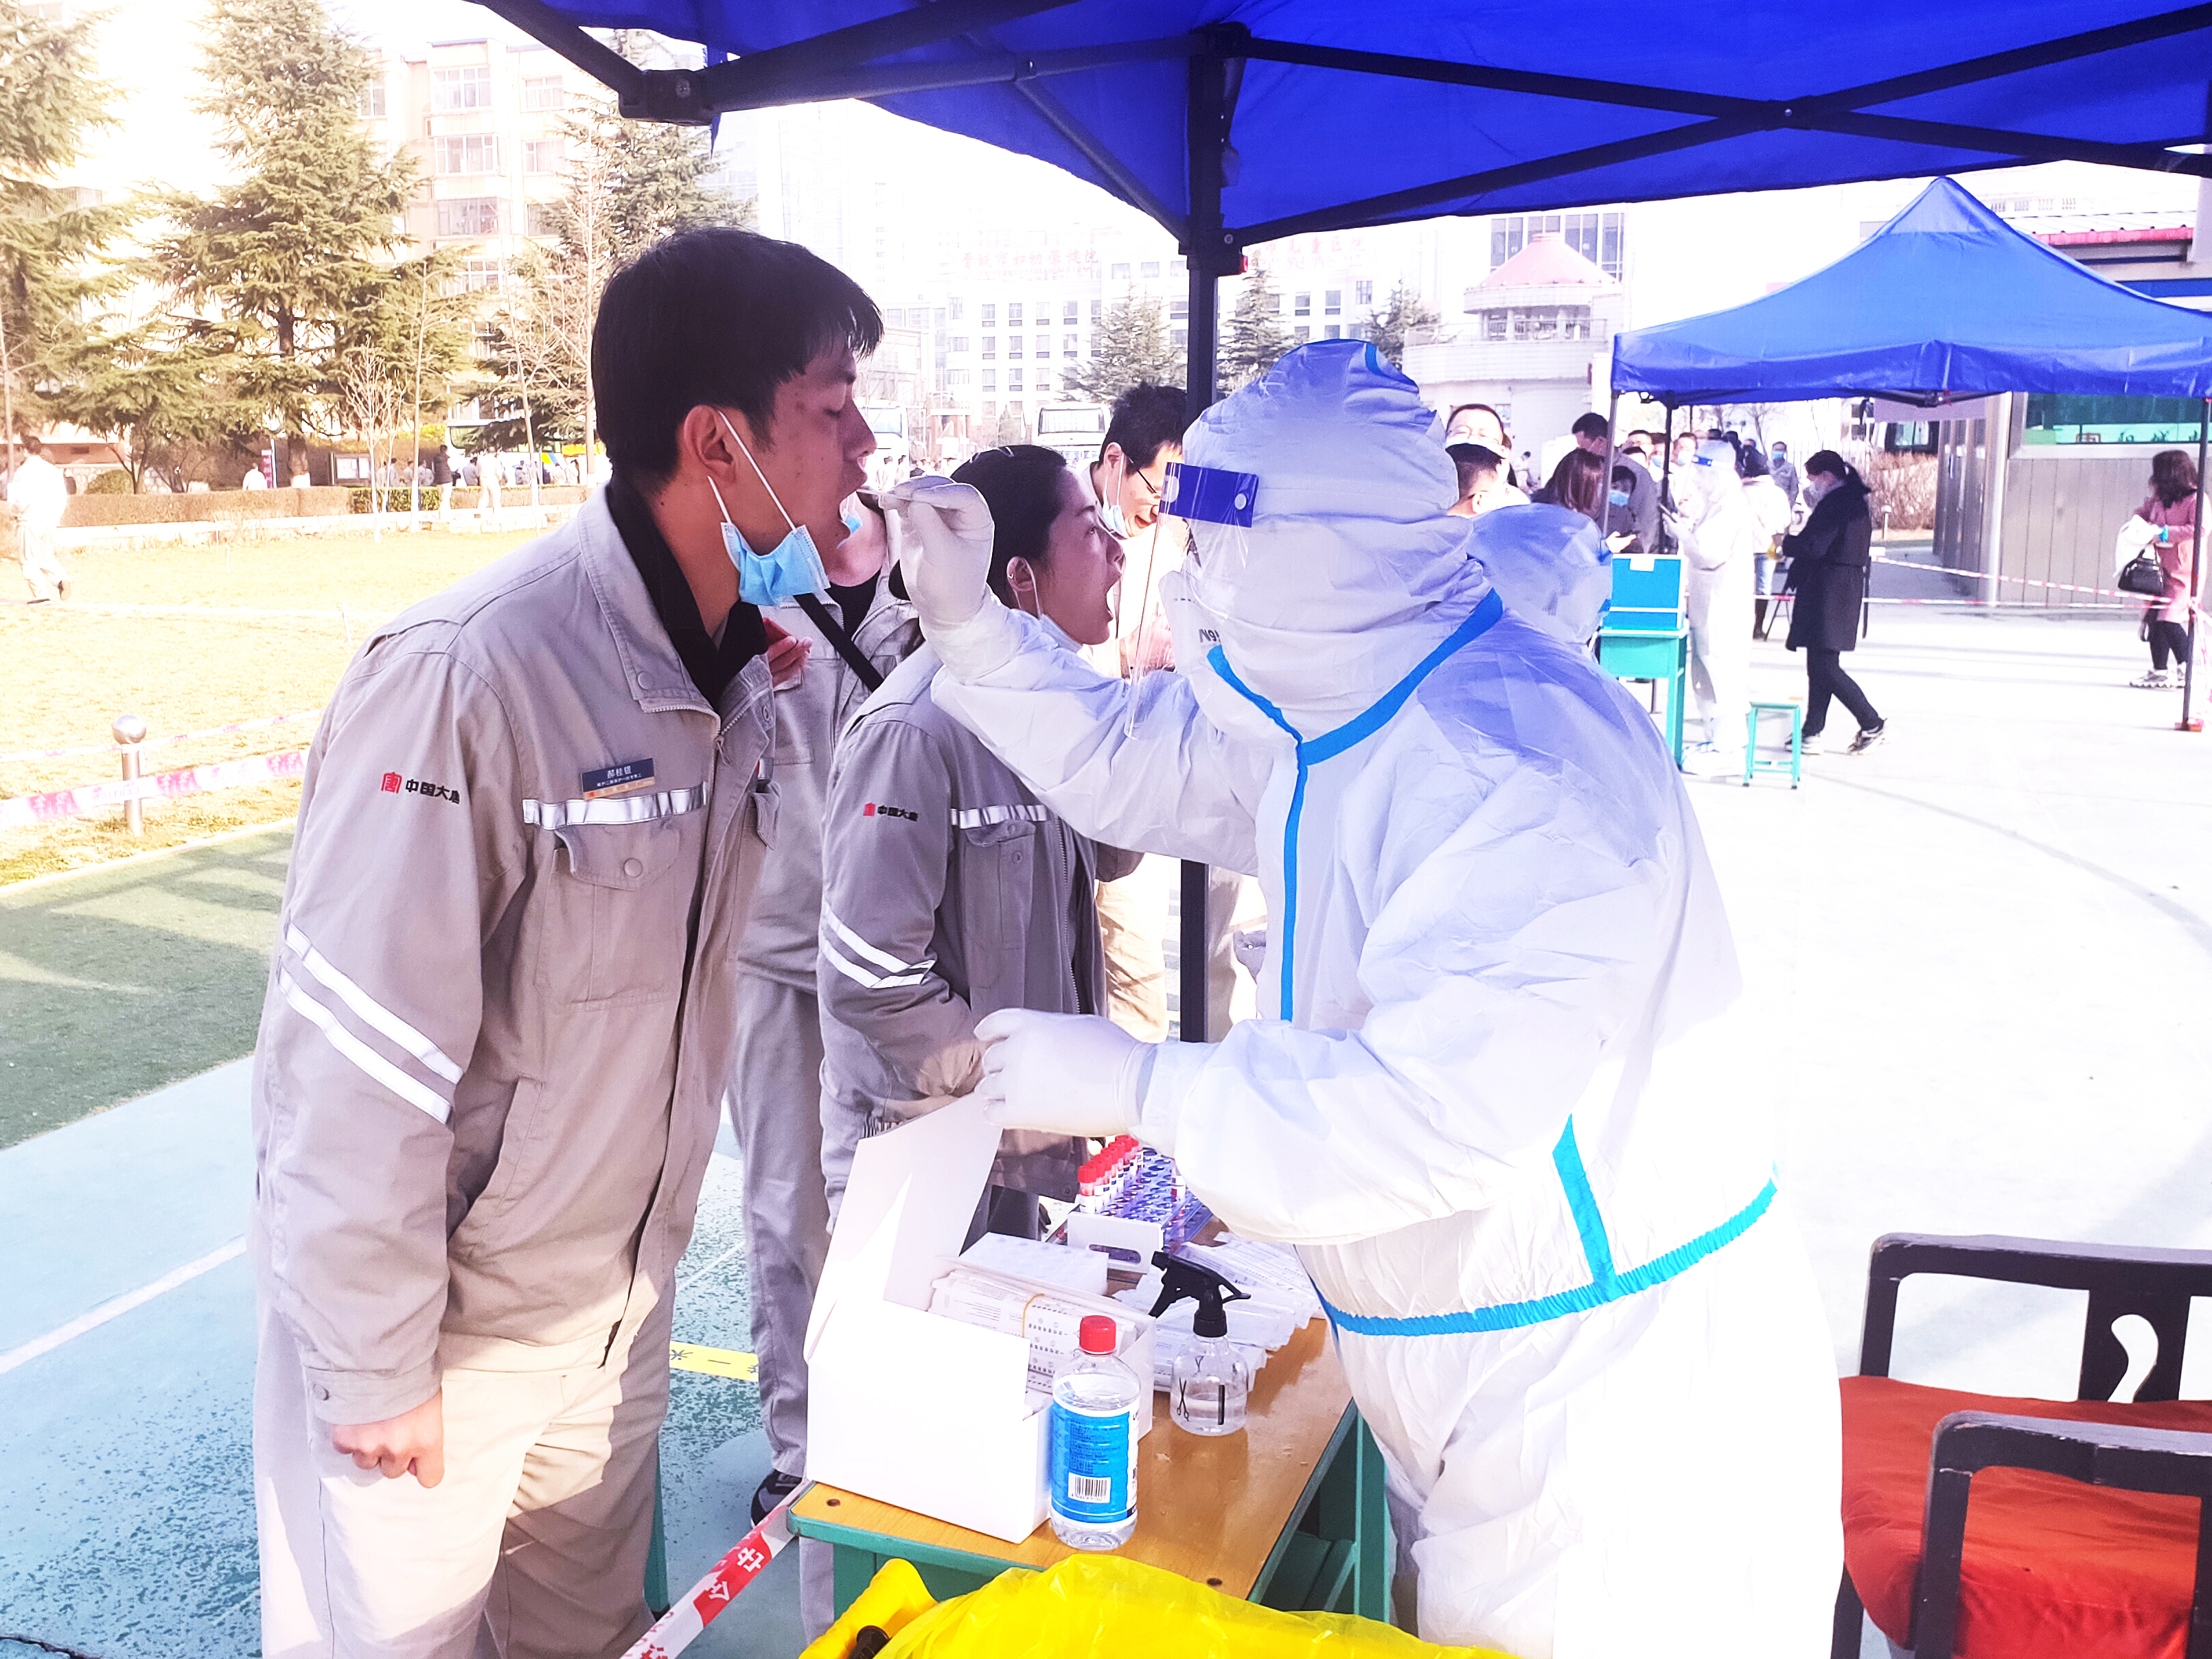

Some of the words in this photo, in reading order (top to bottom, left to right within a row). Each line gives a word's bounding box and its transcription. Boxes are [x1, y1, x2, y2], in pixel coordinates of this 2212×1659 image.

[961, 248, 1098, 270] 晋城市妇幼保健院
[405, 778, 460, 805] 中国大唐
